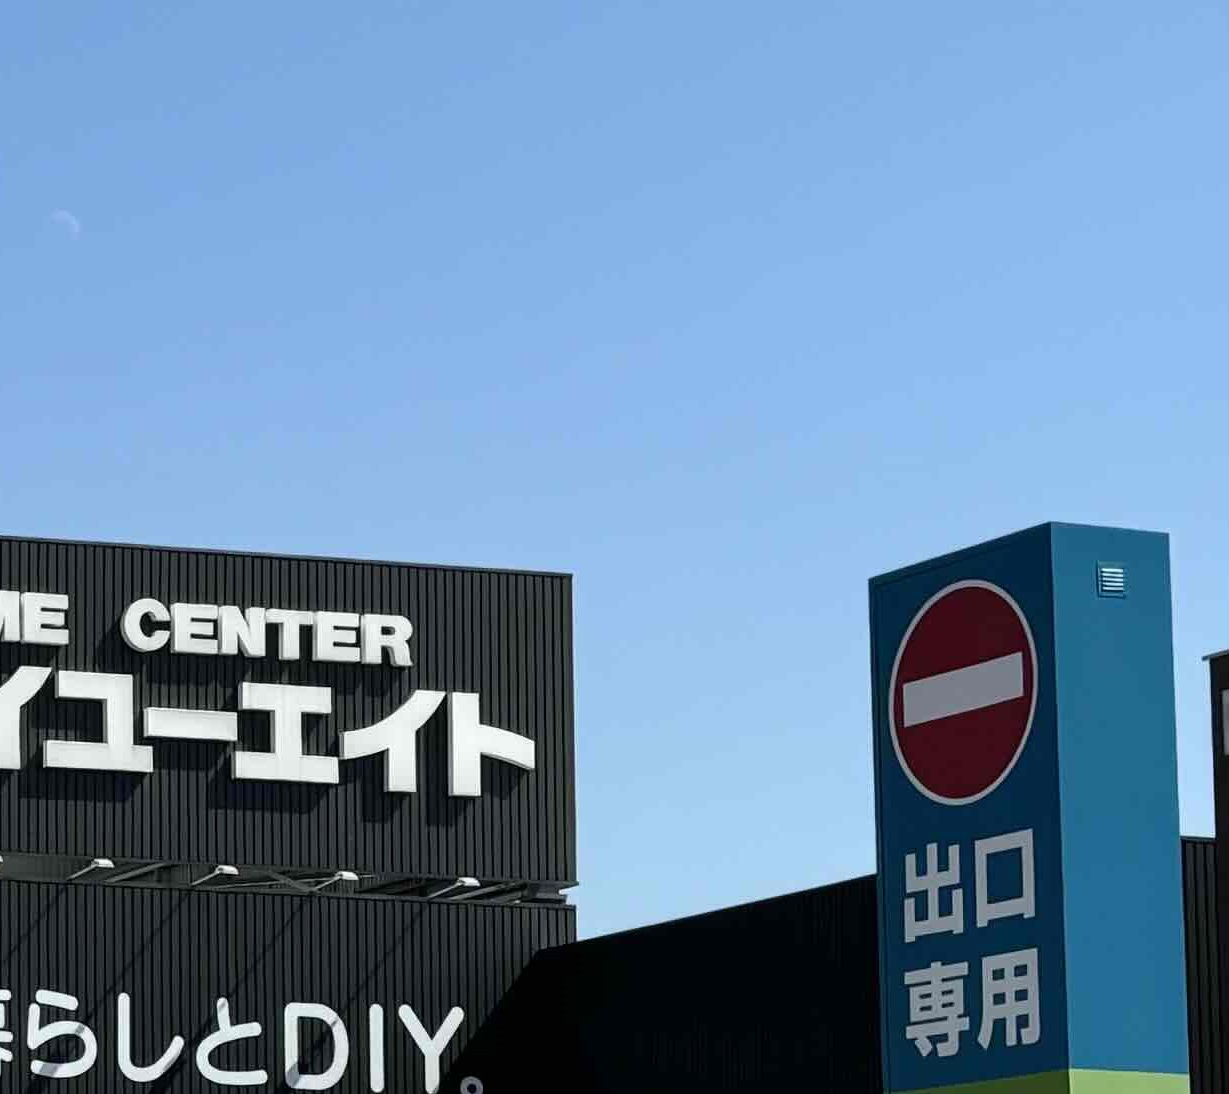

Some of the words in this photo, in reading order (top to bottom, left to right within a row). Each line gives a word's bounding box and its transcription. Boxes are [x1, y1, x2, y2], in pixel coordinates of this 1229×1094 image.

[120, 597, 414, 667] CENTER
[904, 828, 1036, 943] 出口
[904, 947, 1041, 1058] 専用
